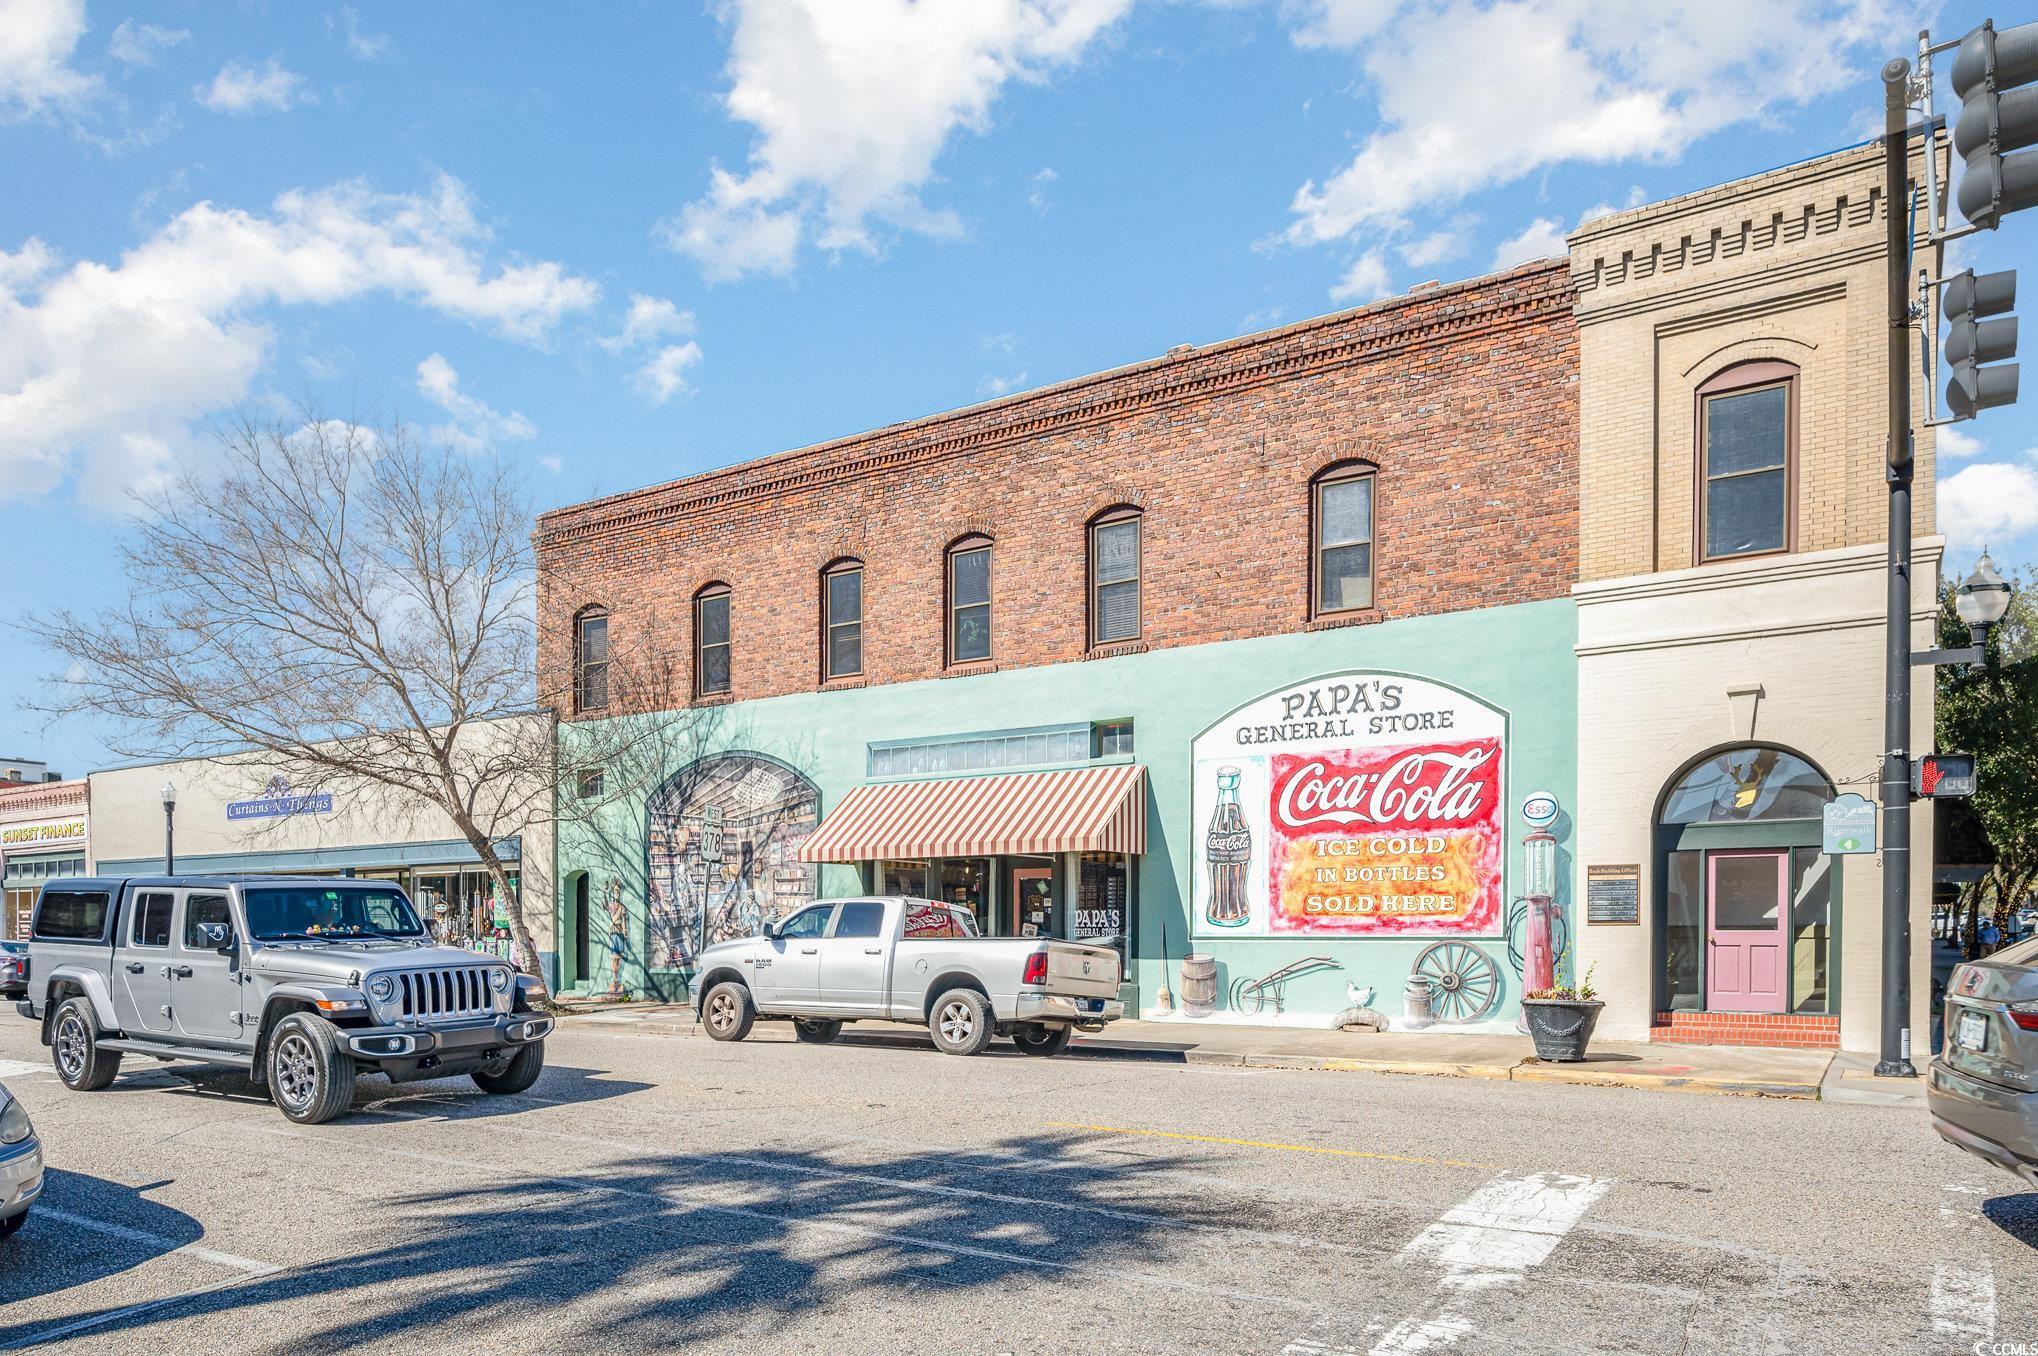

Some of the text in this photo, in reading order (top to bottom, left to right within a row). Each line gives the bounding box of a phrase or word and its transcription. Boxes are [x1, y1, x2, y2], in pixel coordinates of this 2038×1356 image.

[1281, 680, 1403, 721] PAPA'S
[1236, 710, 1455, 745] GENERAL STORE
[1278, 741, 1500, 827] Coca-Cola
[228, 802, 269, 817] Curtains
[707, 807, 720, 820] WEST
[2, 822, 85, 843] SUNSET FINANCE
[703, 831, 721, 853] 378
[1208, 832, 1250, 851] Coca-Cola
[1316, 836, 1447, 857] ICE COLD
[1316, 865, 1446, 883] IN BOTTLES
[1306, 895, 1455, 912] SOLD HERE
[1074, 909, 1120, 927] PAPA'S
[1074, 928, 1120, 937] GENERAL STORE
